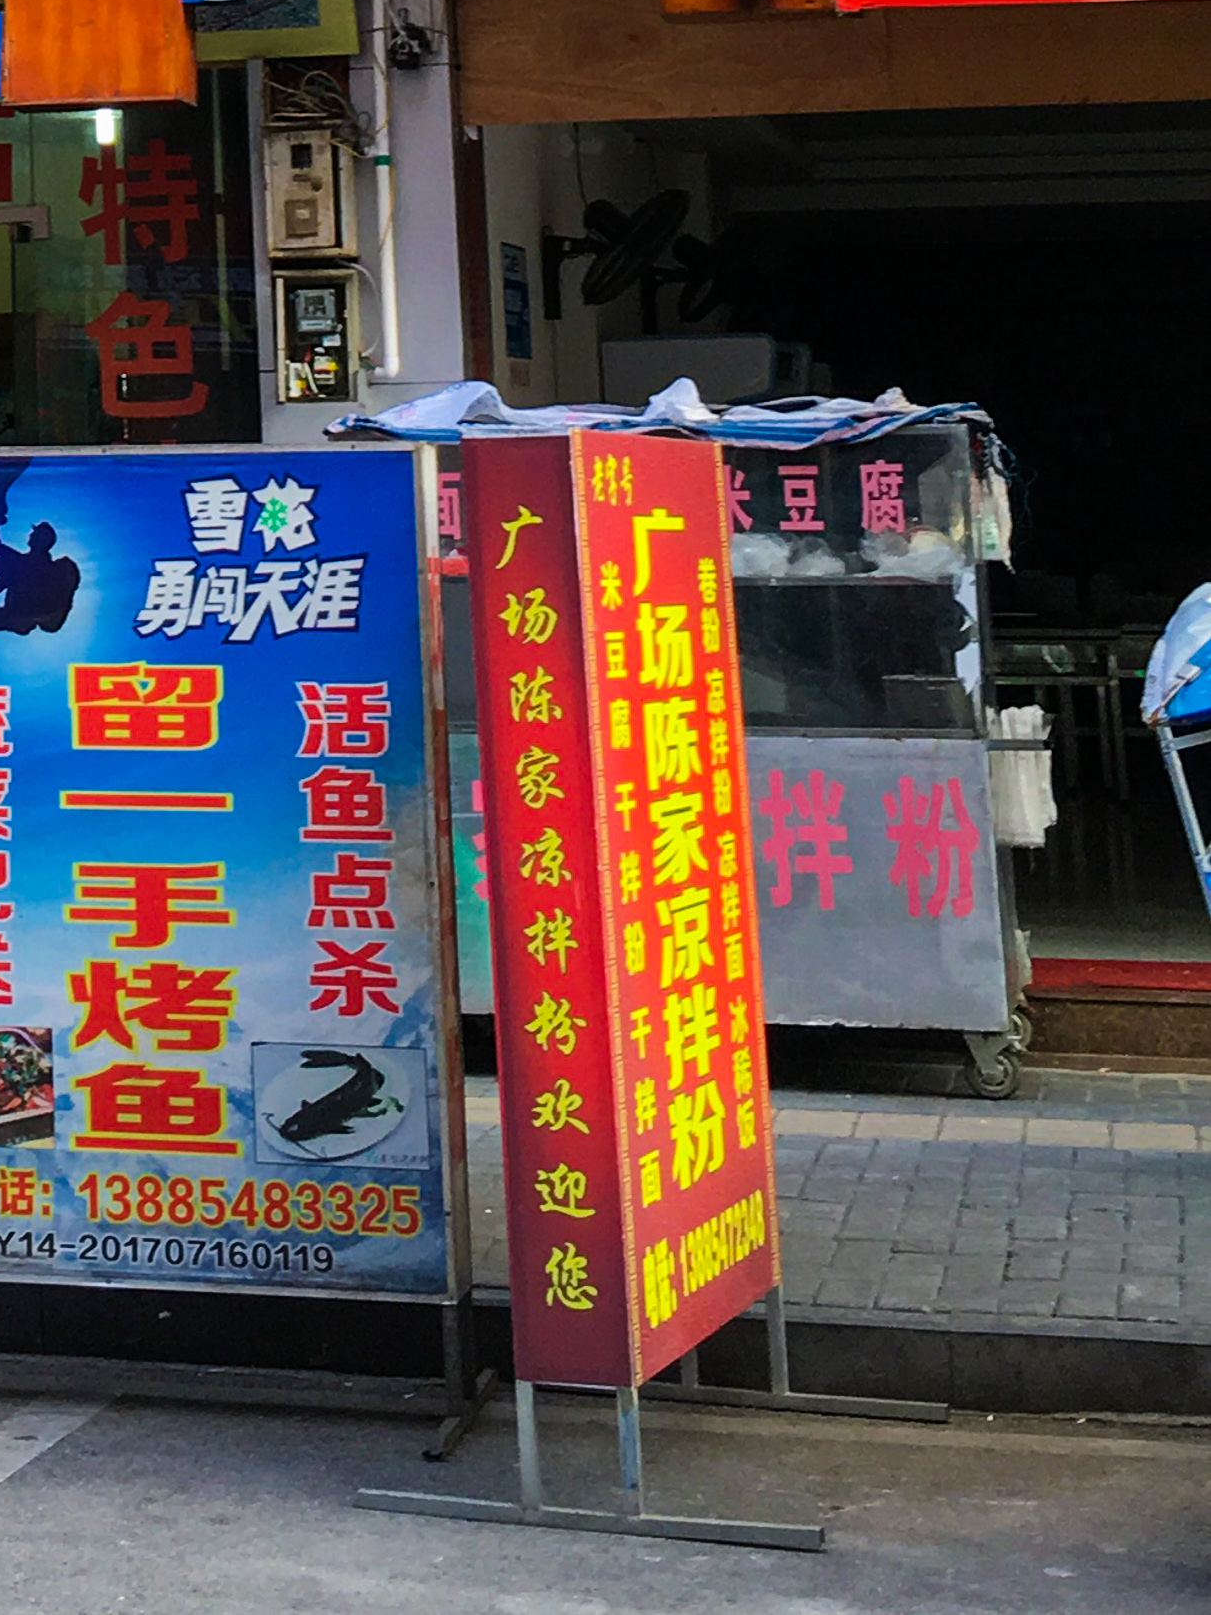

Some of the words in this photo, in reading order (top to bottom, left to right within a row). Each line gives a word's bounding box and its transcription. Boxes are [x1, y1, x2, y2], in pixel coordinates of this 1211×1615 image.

[79, 138, 210, 443] 特色
[135, 553, 368, 643] 勇闯天涯
[185, 475, 318, 552] 雪花
[60, 661, 239, 1158] 留一手烤鱼
[295, 681, 400, 1017] 活鱼点杀
[495, 504, 599, 1311] 广场陈家凉拌粉欢迎您
[632, 508, 726, 1190] 广场陈家凉拌粉
